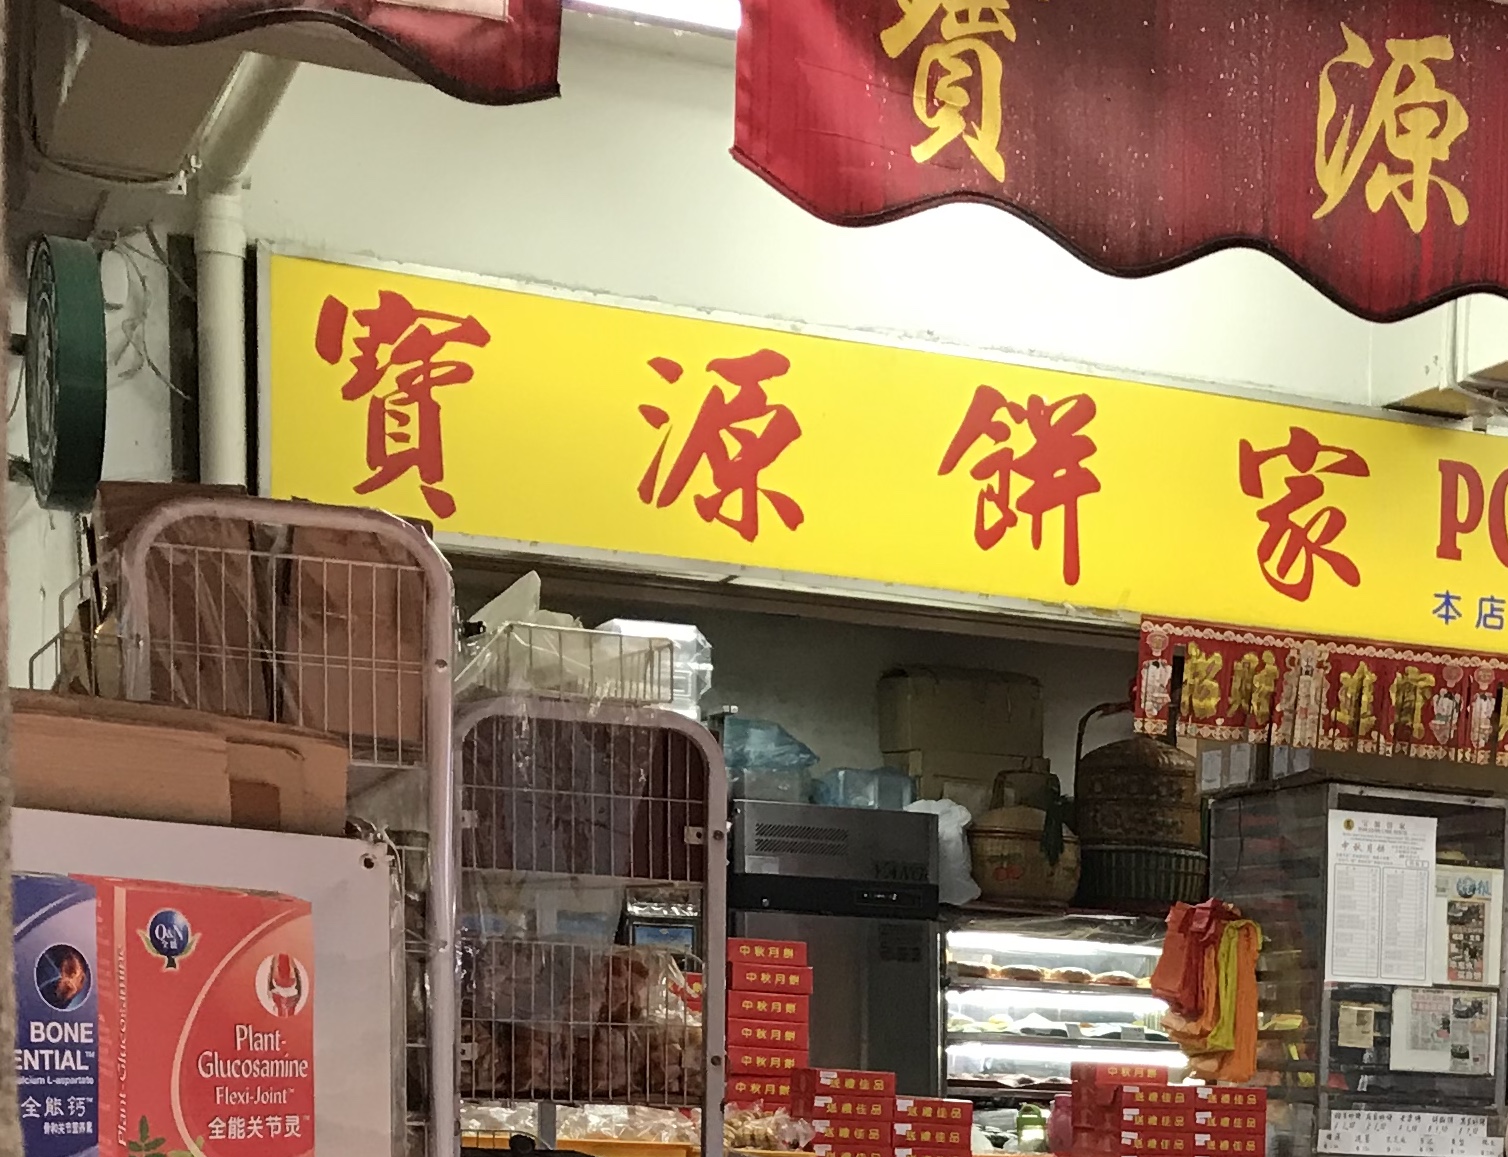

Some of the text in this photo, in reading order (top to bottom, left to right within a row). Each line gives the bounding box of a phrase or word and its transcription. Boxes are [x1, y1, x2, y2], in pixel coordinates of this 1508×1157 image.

[30, 1021, 94, 1043] BONE
[235, 1024, 286, 1052] Plant-
[197, 1051, 308, 1079] Glucosamine
